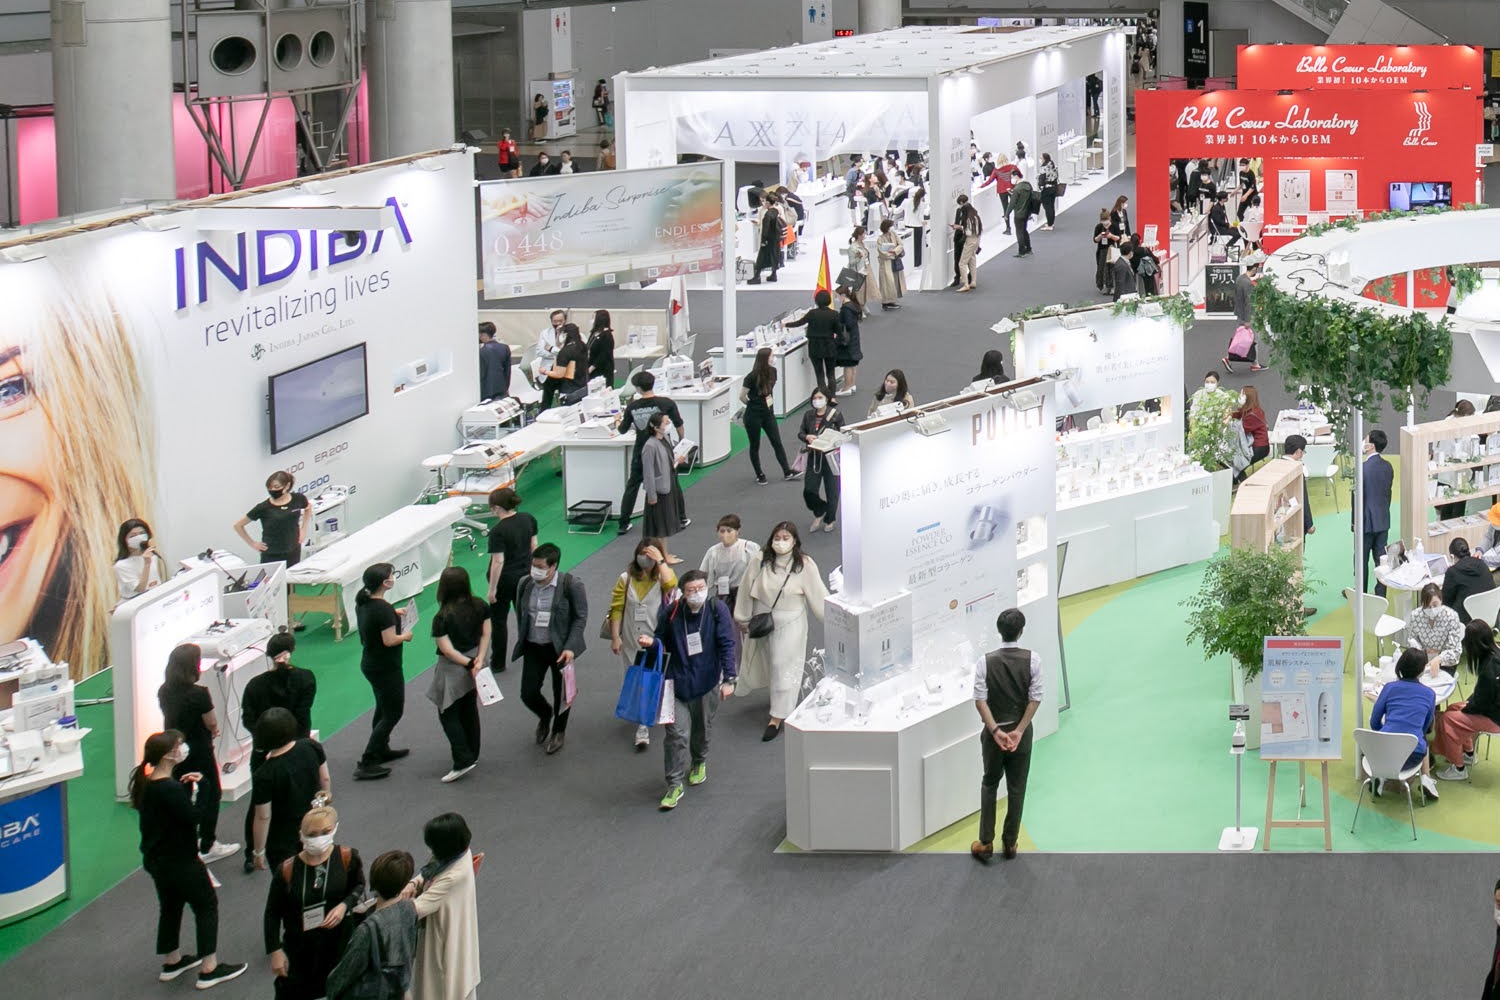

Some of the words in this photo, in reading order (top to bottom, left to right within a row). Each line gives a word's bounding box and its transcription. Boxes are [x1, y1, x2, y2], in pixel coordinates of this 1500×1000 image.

[1197, 20, 1204, 43] 1
[1296, 56, 1328, 73] Belle
[1367, 56, 1427, 77] Laboratory
[1176, 107, 1219, 129] Belle
[1275, 105, 1358, 135] Laboratory
[1252, 134, 1331, 145] 10本からOEM
[542, 192, 599, 230] Indiba
[175, 197, 413, 310] INDIBA
[494, 230, 564, 256] 0.448
[205, 286, 337, 346] revitalizing
[345, 270, 390, 301] lives
[912, 528, 947, 546] POWDER
[394, 562, 419, 579] DIBA
